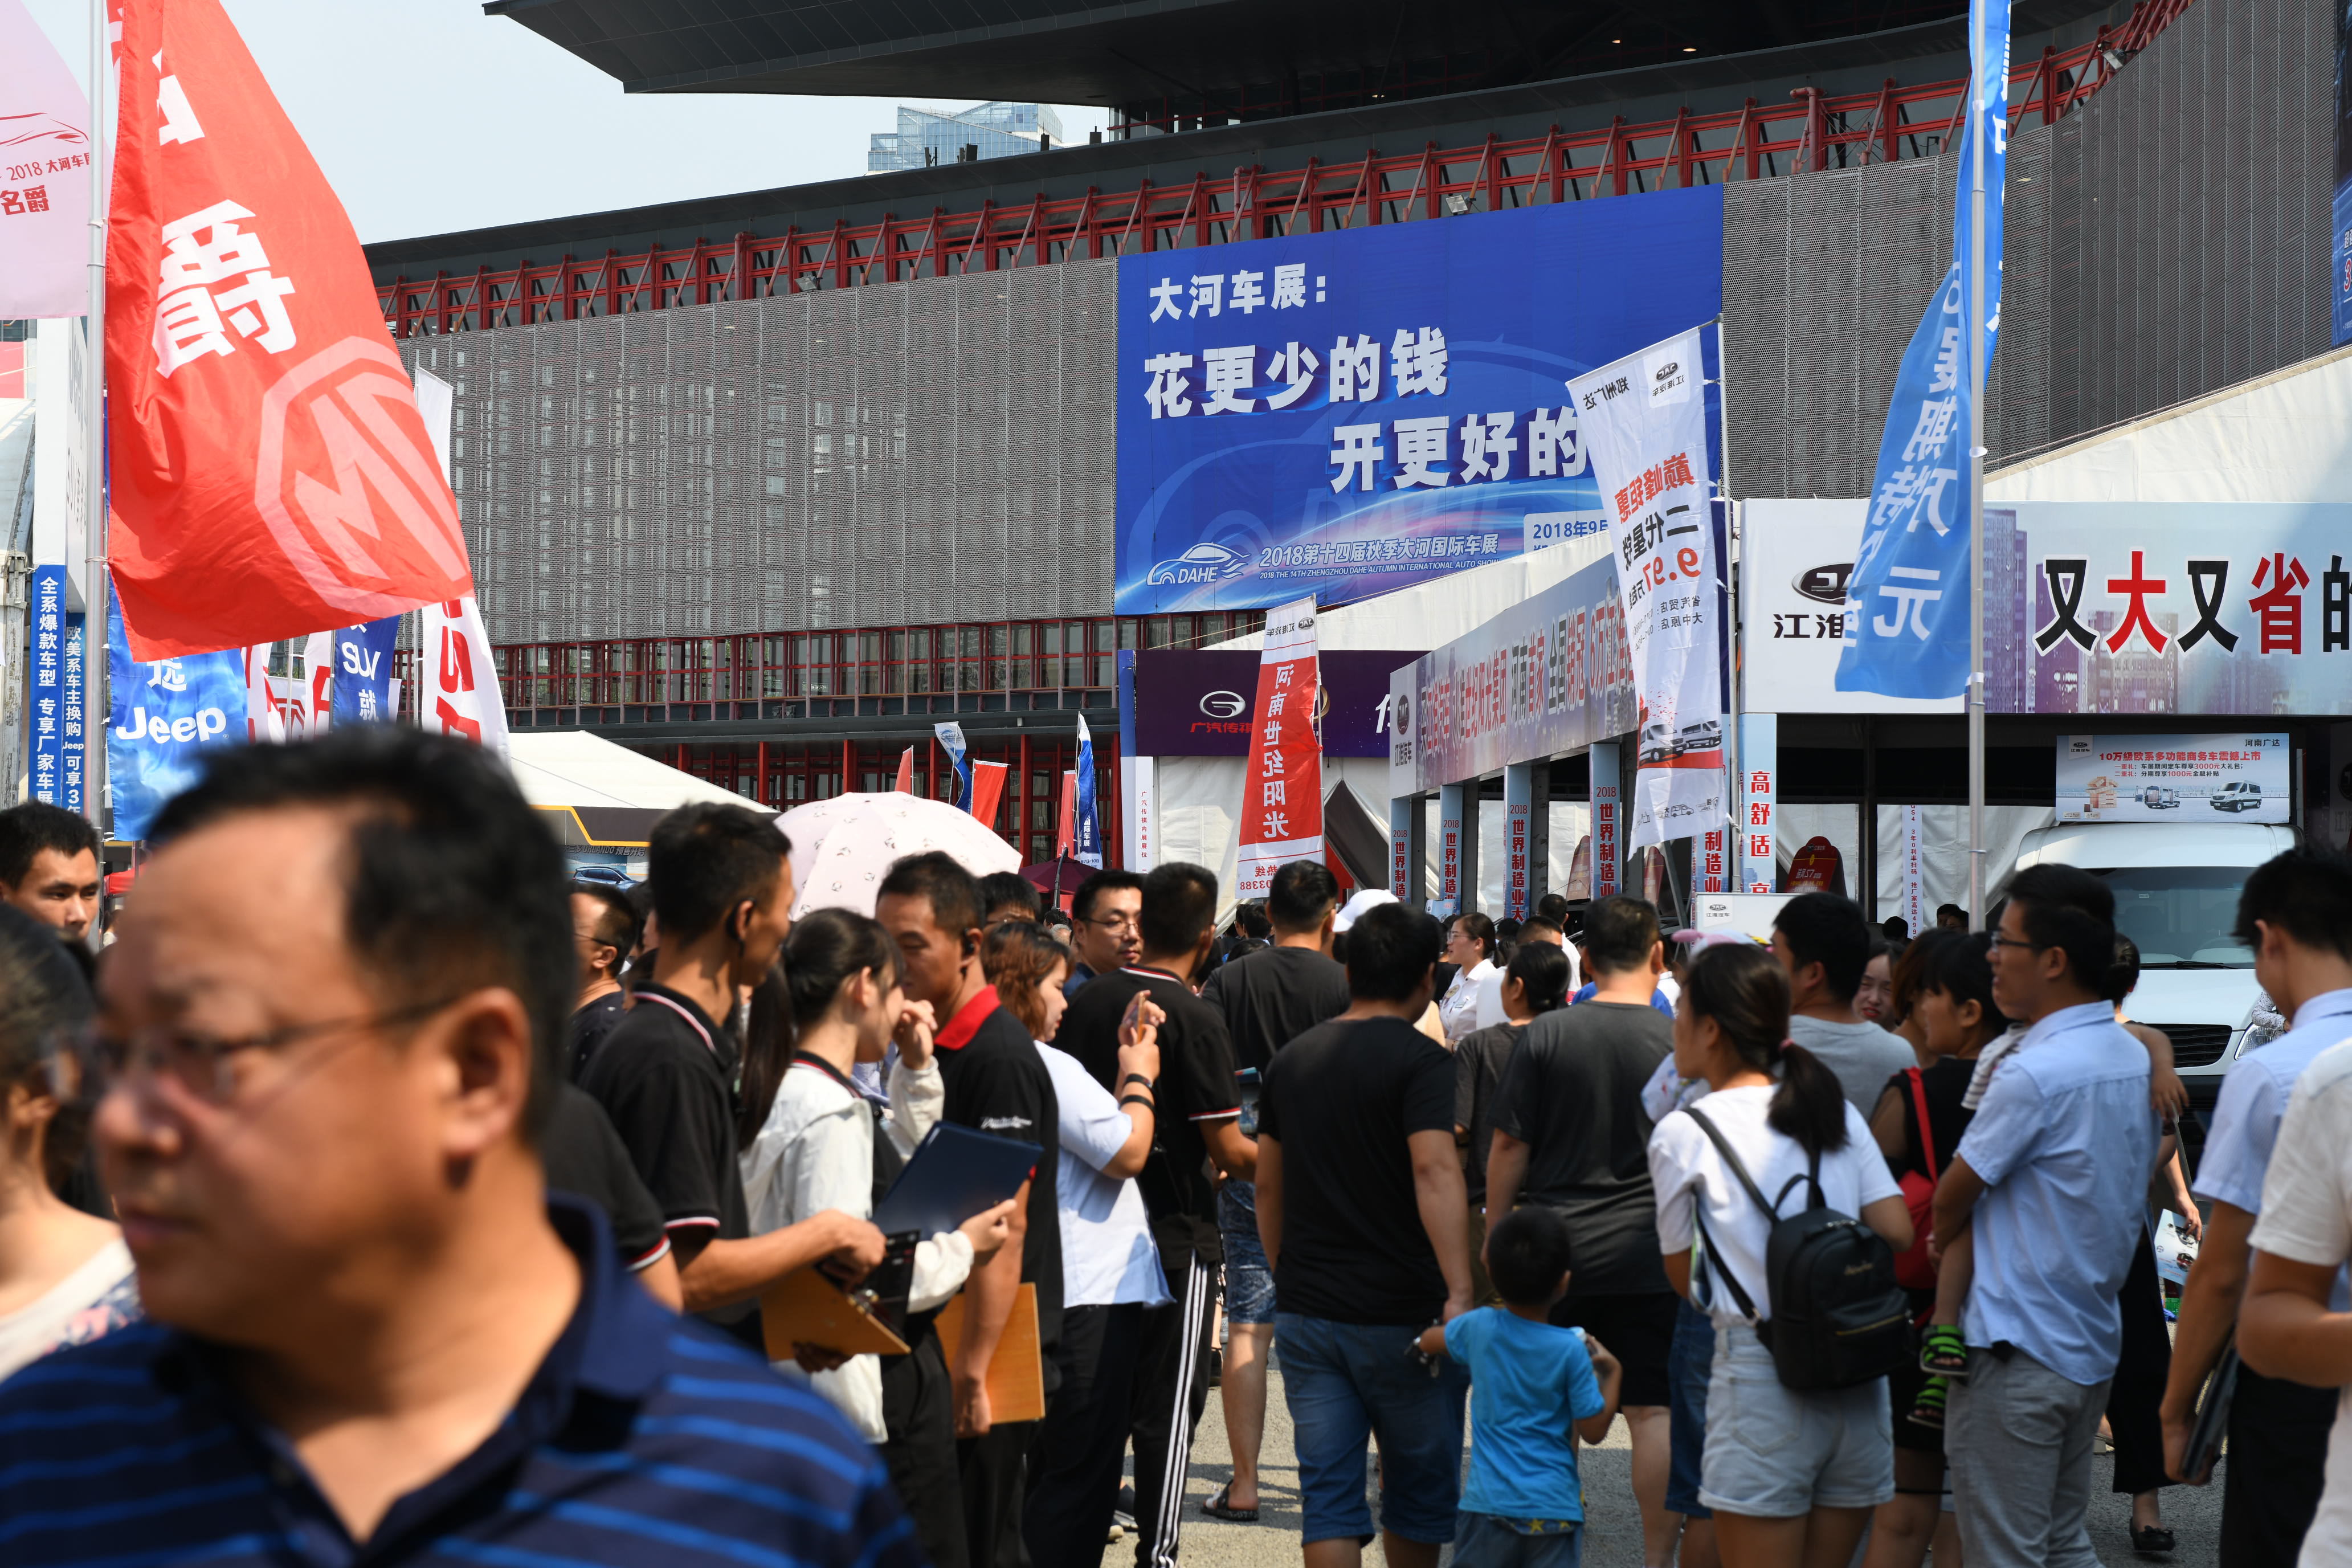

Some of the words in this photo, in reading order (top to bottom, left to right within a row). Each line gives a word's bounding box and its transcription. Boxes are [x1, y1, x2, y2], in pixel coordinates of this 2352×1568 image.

[6, 162, 43, 181] 2018
[0, 185, 50, 215] 名爵
[1150, 263, 1326, 322] 大河车展：
[1144, 326, 1448, 419] 花更少的钱
[1330, 406, 1589, 494] 开更好的
[1259, 533, 1500, 567] 2018第十四届秋季大河国际车展
[1178, 566, 1218, 583] DAHE
[1307, 567, 1349, 577] ZHENGZHOU
[1368, 564, 1397, 573] AUTUMN
[1398, 561, 1453, 571] INTERNATIONAL
[1455, 560, 1476, 569] AUTO
[38, 577, 59, 686] 全系爆款车型
[342, 642, 381, 681] SUV
[1510, 627, 1545, 726] 河南首家
[1549, 607, 1586, 714] 全国销冠
[66, 626, 82, 736] 欧美系车主换购
[358, 688, 379, 722] 就
[116, 707, 226, 744] Jeep
[2245, 738, 2280, 747] 河南广达
[36, 698, 56, 806] 专享厂家车展
[63, 741, 84, 750] Jeep
[1395, 740, 1412, 766] 江淮汽车
[1596, 786, 1616, 797] 2018
[1444, 819, 1459, 828] 2018
[1510, 804, 1528, 814] 2018
[1750, 771, 1770, 857] 高舒适
[615, 847, 646, 856] 预售开启
